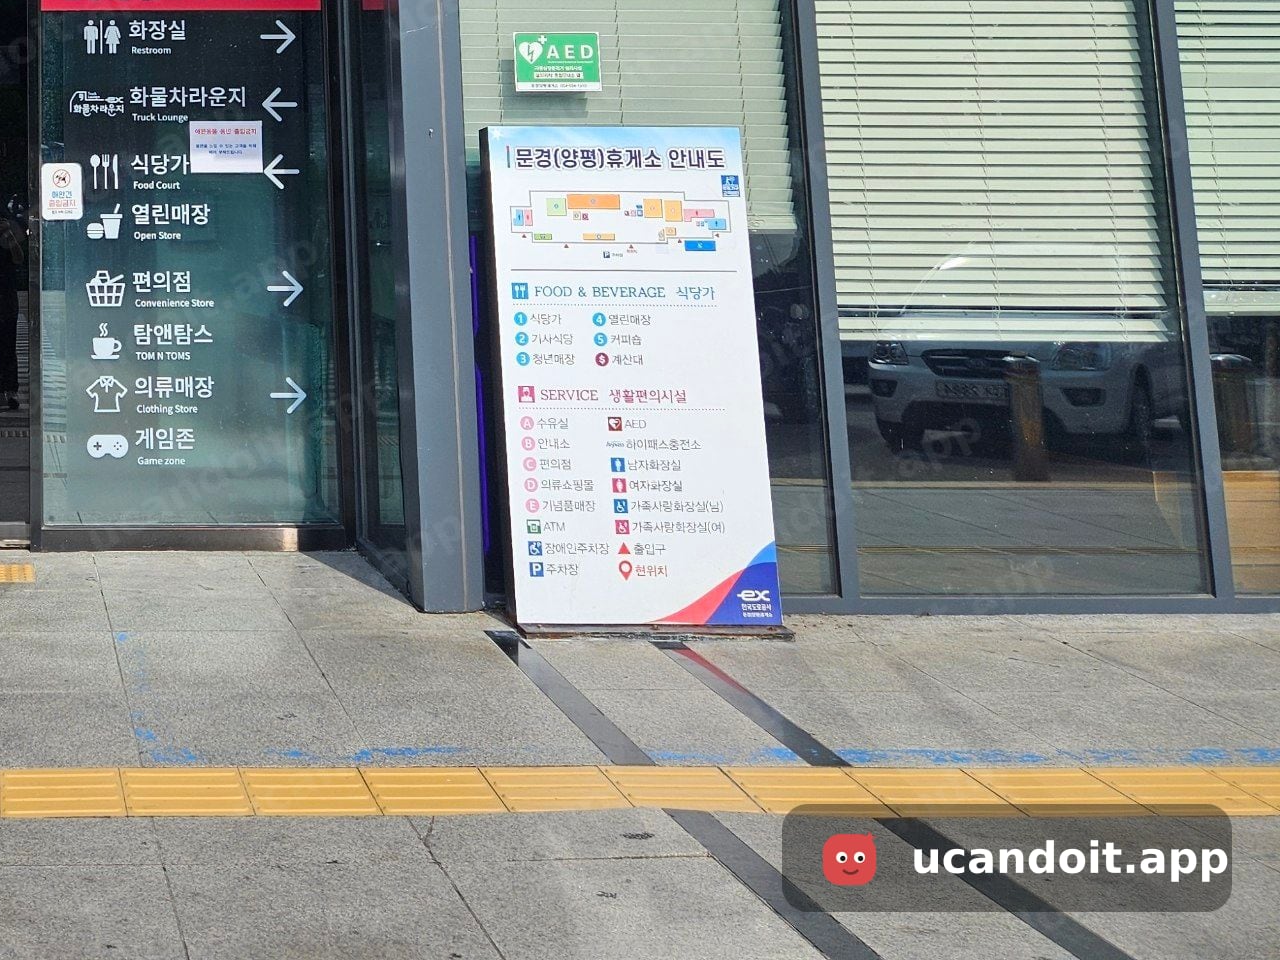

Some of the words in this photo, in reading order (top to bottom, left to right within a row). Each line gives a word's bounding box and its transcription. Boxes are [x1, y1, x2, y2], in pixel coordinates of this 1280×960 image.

[129, 20, 187, 41] 화장실
[131, 46, 171, 55] Restroom
[546, 44, 594, 59] AED
[129, 86, 246, 108] 화물차라운지
[132, 113, 156, 122] Truck
[157, 113, 189, 123] Lounge
[130, 154, 190, 175] 식당가
[516, 148, 661, 169] 문경(양평)휴게소
[669, 148, 726, 169] 안내도
[133, 181, 155, 190] Food
[156, 181, 180, 190] Court
[131, 204, 211, 225] 열린매장
[134, 231, 157, 241] Open
[158, 231, 181, 240] Store
[132, 270, 191, 293] 편의점
[534, 286, 572, 298] FOOD
[578, 286, 587, 298] &
[592, 286, 666, 298] BEVERAGE
[676, 286, 716, 300] 식당가
[135, 298, 190, 308] Convenience
[191, 298, 214, 308] Store
[530, 313, 562, 325] 식당가
[608, 314, 651, 326] 열린매장
[133, 324, 213, 345] 탐앤탐스
[531, 333, 573, 346] 기사식당
[609, 333, 642, 346] 커피숍
[136, 351, 155, 360] TOM
[157, 351, 164, 360] N
[165, 351, 191, 360] TOMS
[532, 353, 576, 366] 청년매장
[611, 353, 644, 366] 계산대
[134, 375, 215, 398] 의류매장
[540, 389, 599, 401] SERVICE
[609, 389, 687, 404] 생활편의시설
[136, 404, 174, 415] Clothing
[175, 404, 198, 414] Store
[536, 417, 569, 430] 수유실
[624, 419, 647, 428] AED
[135, 427, 195, 450] 게임존
[537, 438, 570, 450] 안내소
[626, 438, 702, 451] 하이패스충전소
[137, 456, 163, 465] Game
[539, 458, 572, 471] 편의점
[627, 459, 682, 472] 남자화장실
[541, 479, 594, 491] 의류쇼핑몰
[629, 479, 683, 492] 여자화장실
[542, 500, 596, 512] 기념품매장
[543, 521, 565, 532] ATM
[544, 542, 610, 555] 장애인주차장
[633, 543, 666, 556] 출입구
[546, 563, 579, 576] 주차장
[635, 564, 668, 577] 현위치
